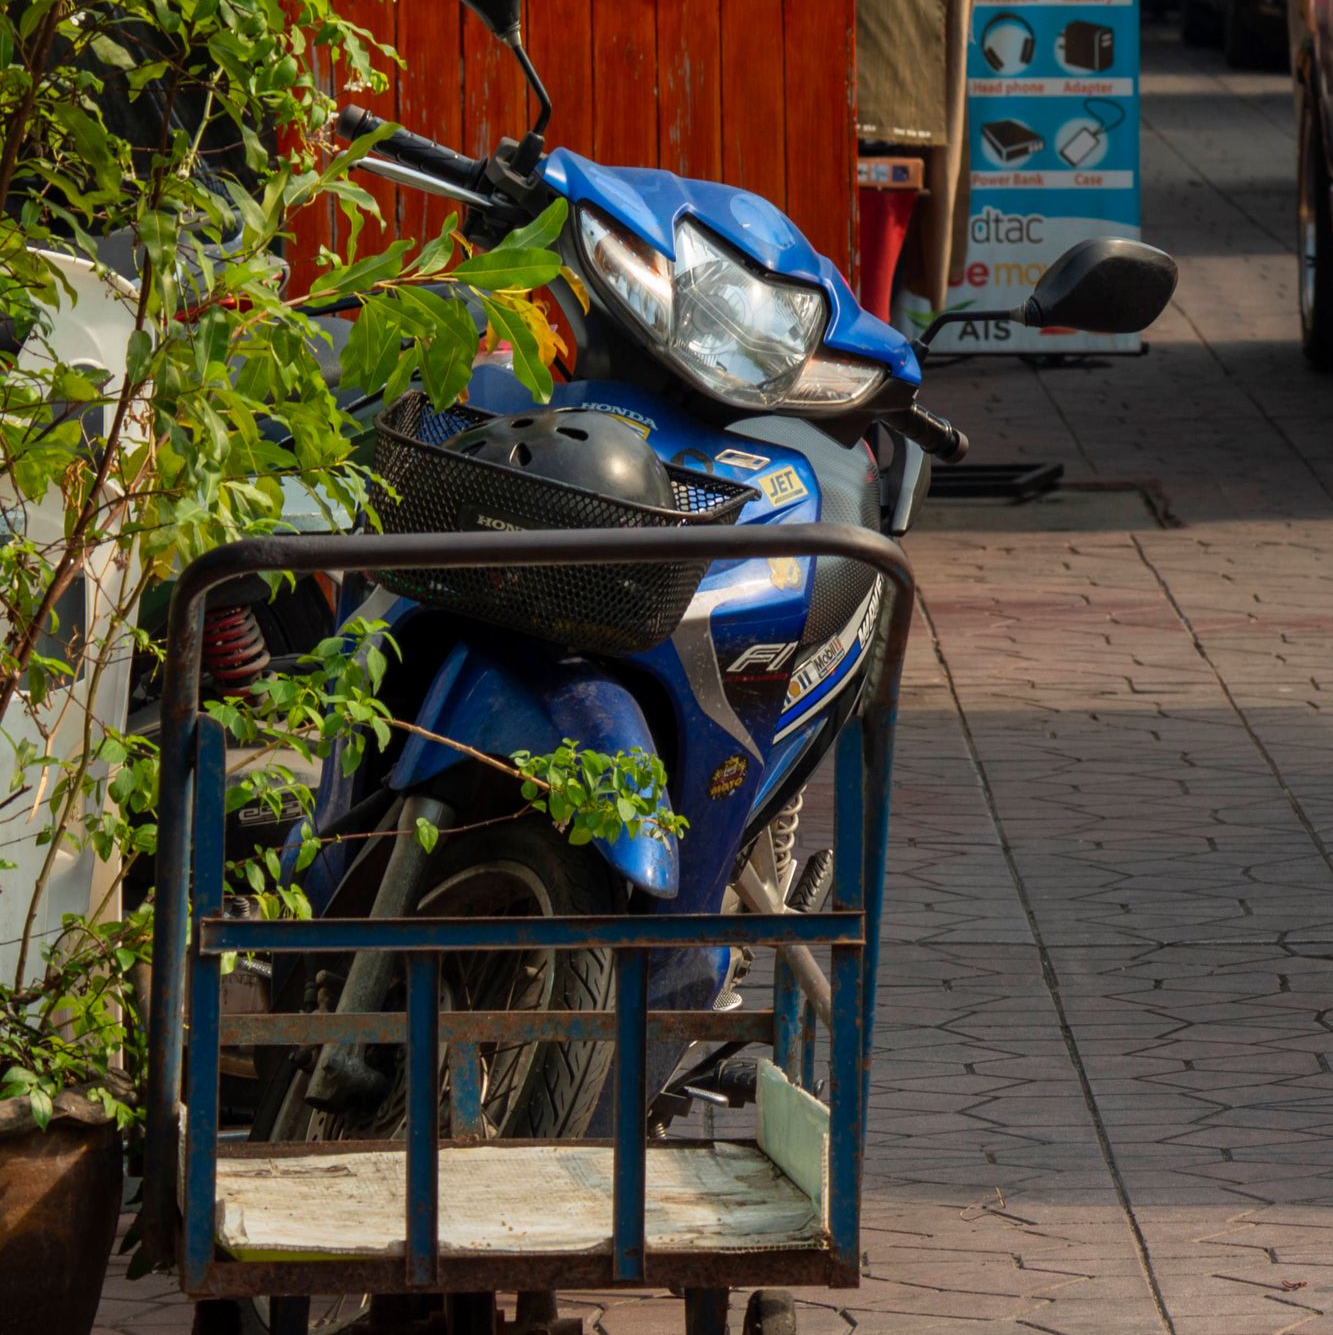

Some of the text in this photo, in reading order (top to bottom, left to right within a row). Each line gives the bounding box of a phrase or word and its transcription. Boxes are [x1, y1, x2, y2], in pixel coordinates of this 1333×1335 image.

[973, 81, 1045, 95] Head phone
[1063, 81, 1114, 95] Adapter
[972, 173, 1044, 186] Power Bank
[1074, 173, 1103, 186] Case
[970, 209, 1044, 244] dtac
[958, 320, 1012, 341] AIS
[580, 402, 659, 432] HONDA
[770, 470, 795, 498] JET
[476, 514, 530, 531] HON
